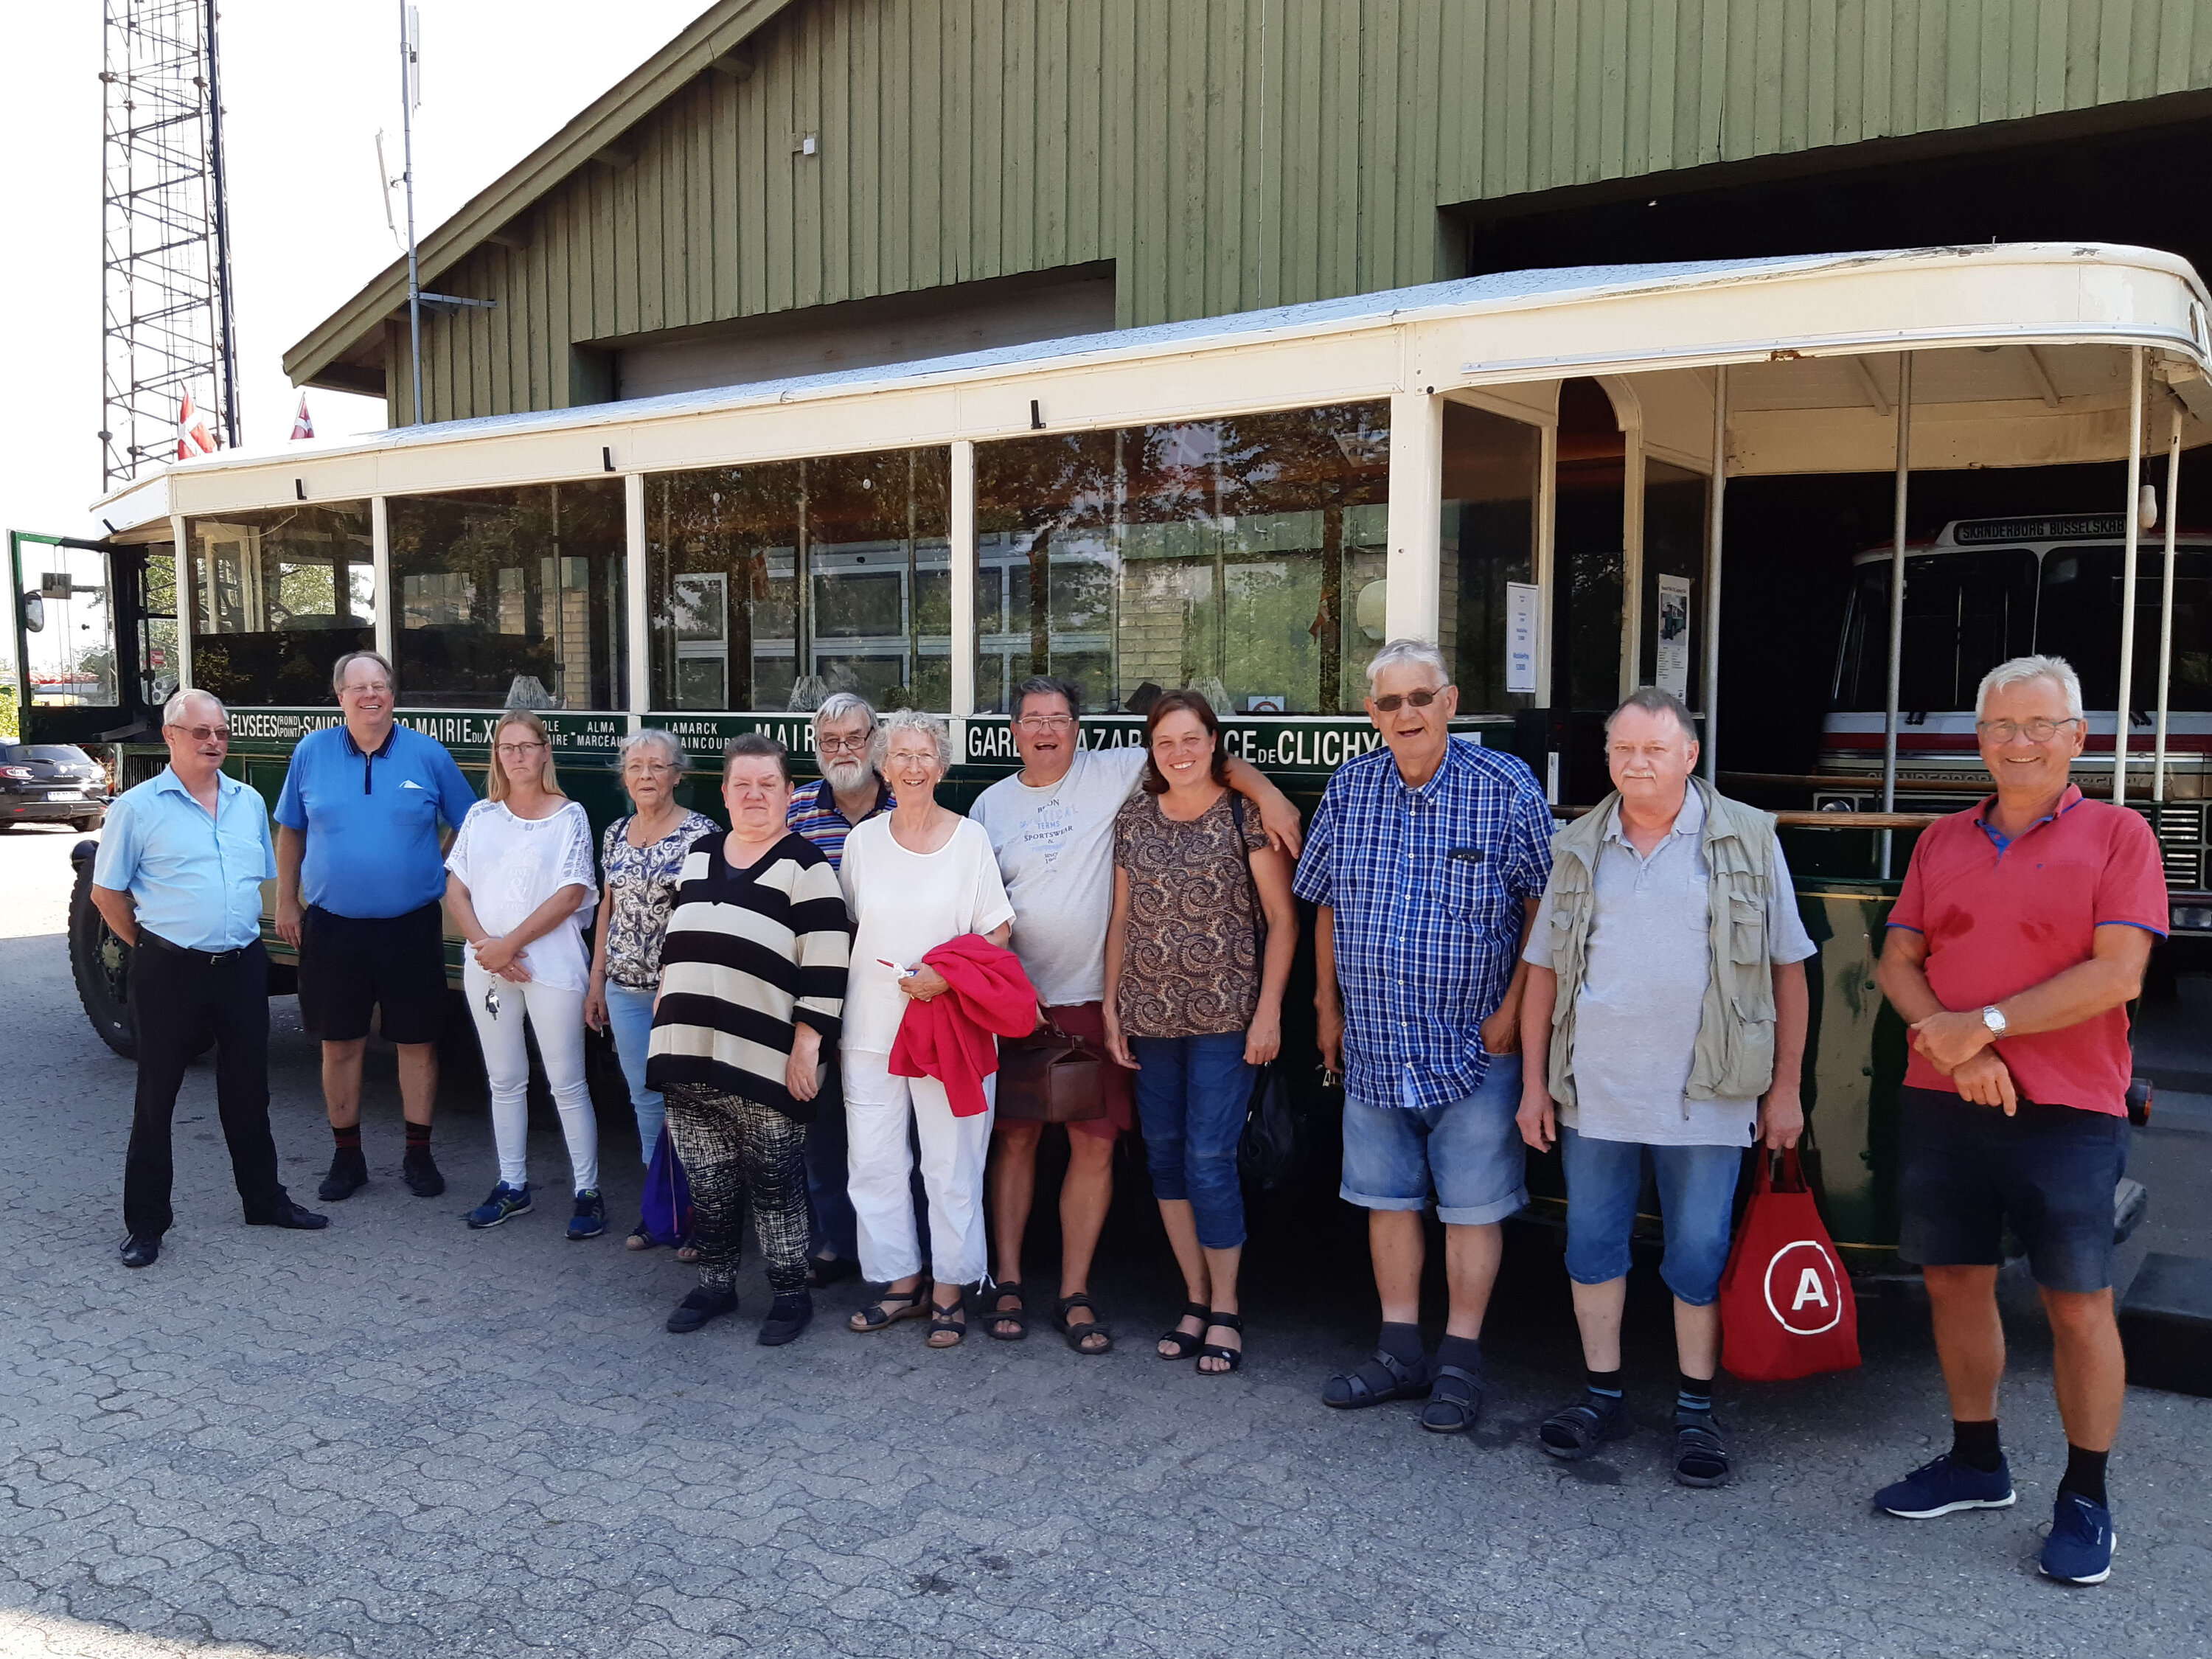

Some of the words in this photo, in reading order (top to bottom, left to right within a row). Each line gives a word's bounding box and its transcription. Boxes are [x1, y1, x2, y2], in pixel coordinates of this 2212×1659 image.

[1962, 524, 2044, 539] SKANDERBORG
[2050, 519, 2124, 535] BUSSELSKAB
[416, 717, 472, 743] MAIRIE
[472, 732, 483, 743] DU
[587, 721, 615, 733] ALMA
[665, 722, 718, 735] LAMARCK
[755, 723, 816, 752] MAIR
[1258, 748, 1276, 764] DE
[1277, 730, 1381, 766] CLICHY
[1024, 825, 1074, 842] SPORTSWEAR
[1791, 1267, 1829, 1310] A
